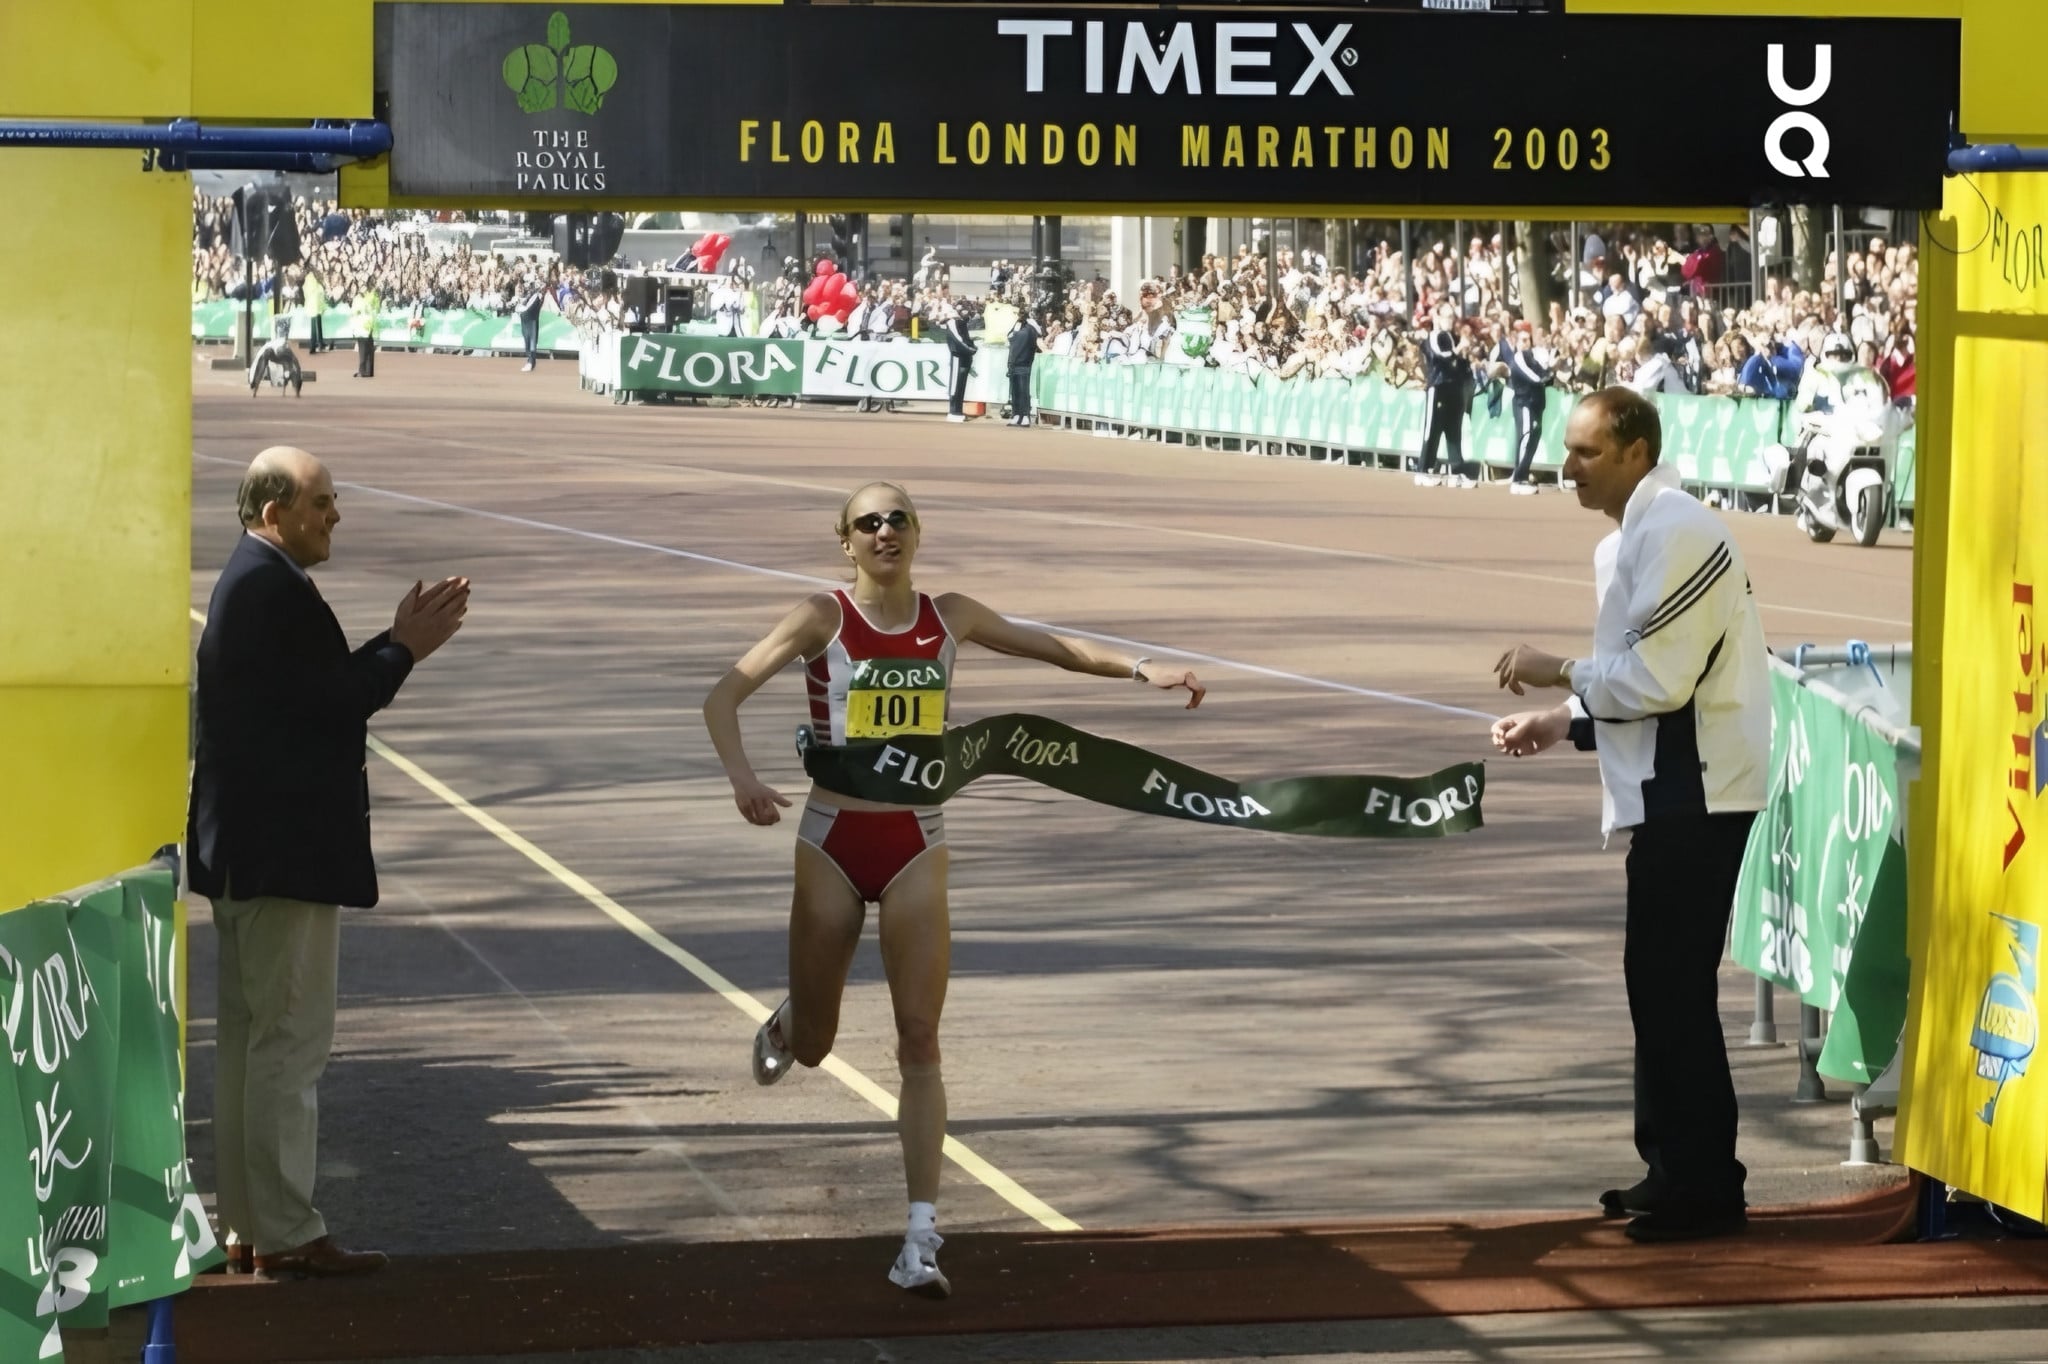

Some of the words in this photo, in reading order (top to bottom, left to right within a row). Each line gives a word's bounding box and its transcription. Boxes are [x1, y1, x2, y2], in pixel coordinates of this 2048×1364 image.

[997, 19, 1354, 96] TIMEX
[516, 151, 606, 169] ROYAL
[533, 130, 588, 148] THE
[739, 119, 895, 164] FLORA
[937, 121, 1137, 166] LONDON
[1181, 124, 1449, 169] MARATHON
[1492, 127, 1612, 171] 2003
[517, 172, 606, 191] PARKS
[627, 336, 796, 387] FLORA
[814, 344, 978, 393] FLOR
[874, 694, 921, 727] 101
[1005, 725, 1079, 767] FLORA
[1141, 768, 1272, 818] FLORA
[1363, 774, 1479, 827] FLORA
